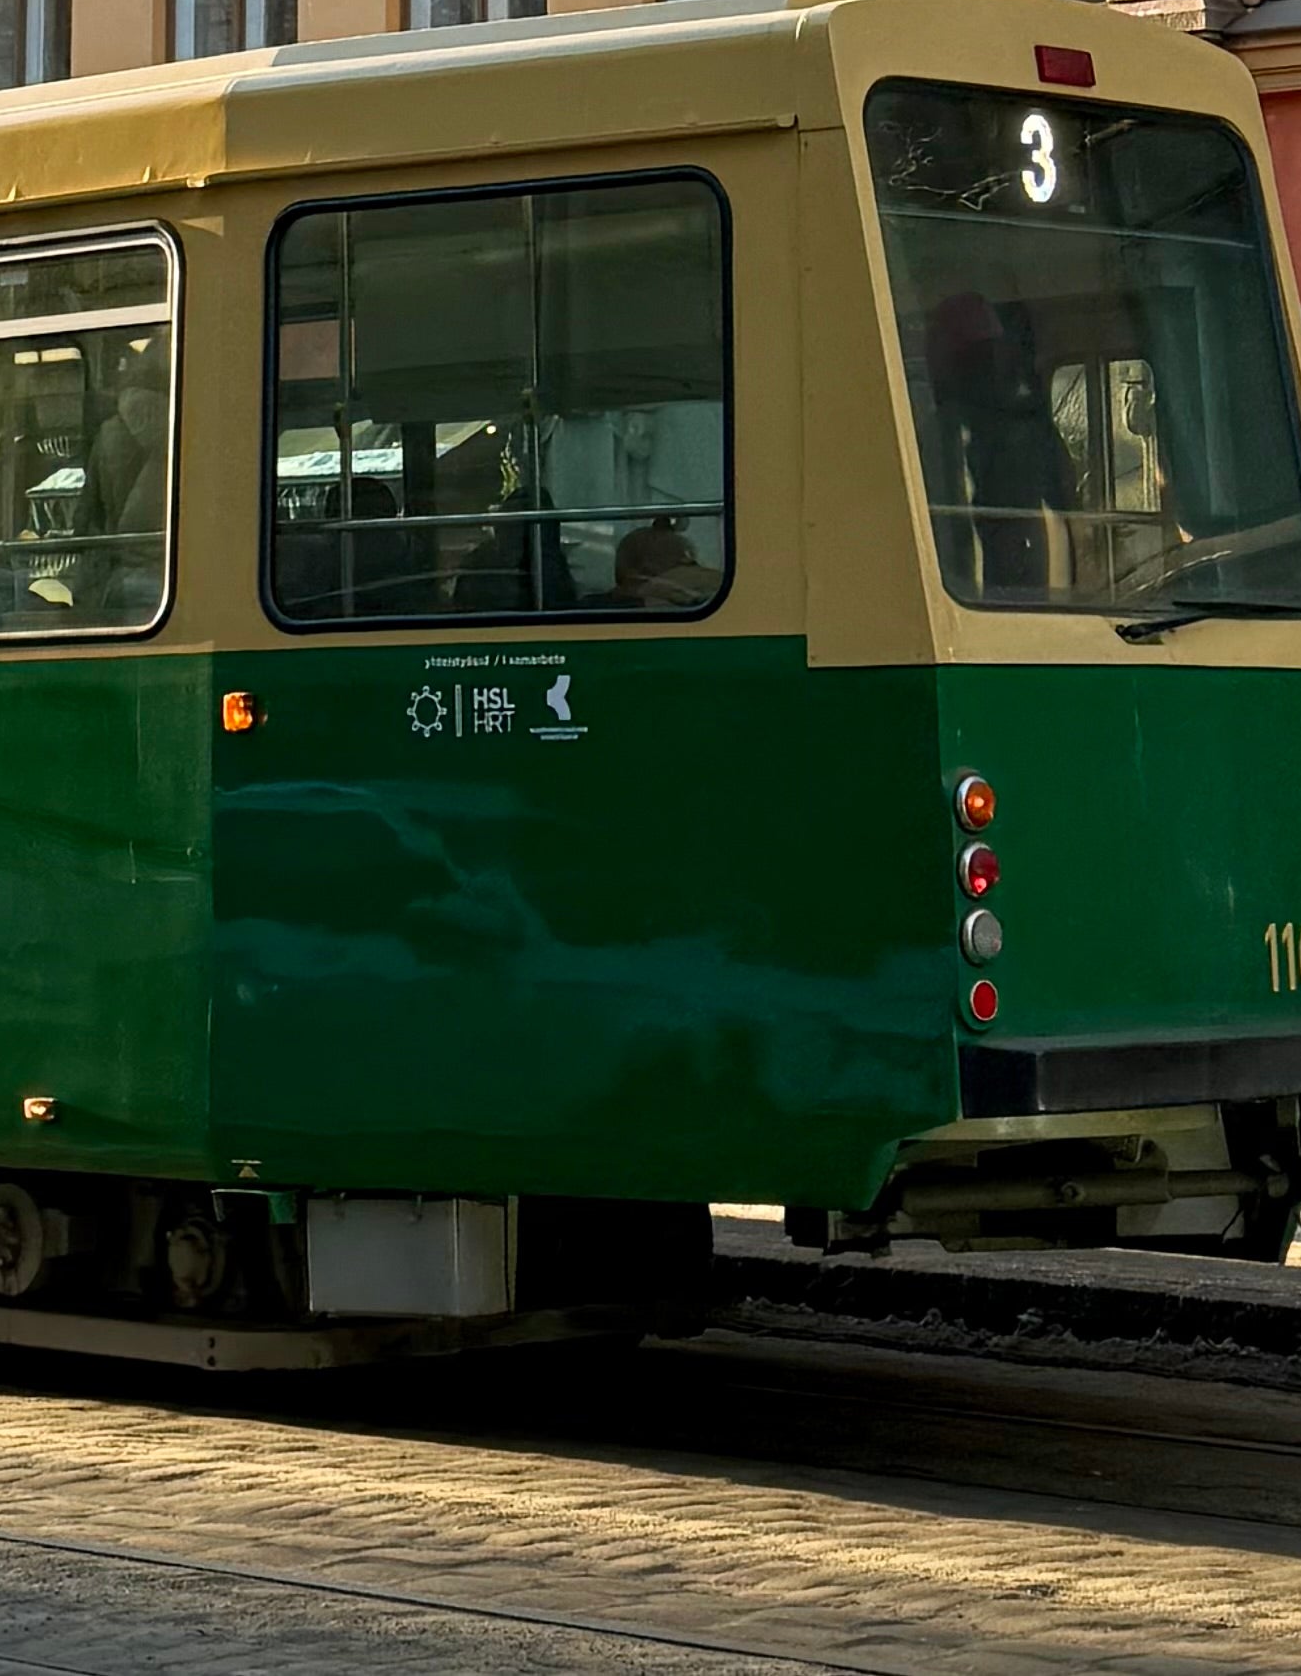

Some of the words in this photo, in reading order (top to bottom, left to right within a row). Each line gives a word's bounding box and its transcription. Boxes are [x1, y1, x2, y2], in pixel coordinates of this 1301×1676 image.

[1019, 112, 1058, 204] 3
[473, 687, 516, 710] HSL
[474, 711, 516, 734] HRT
